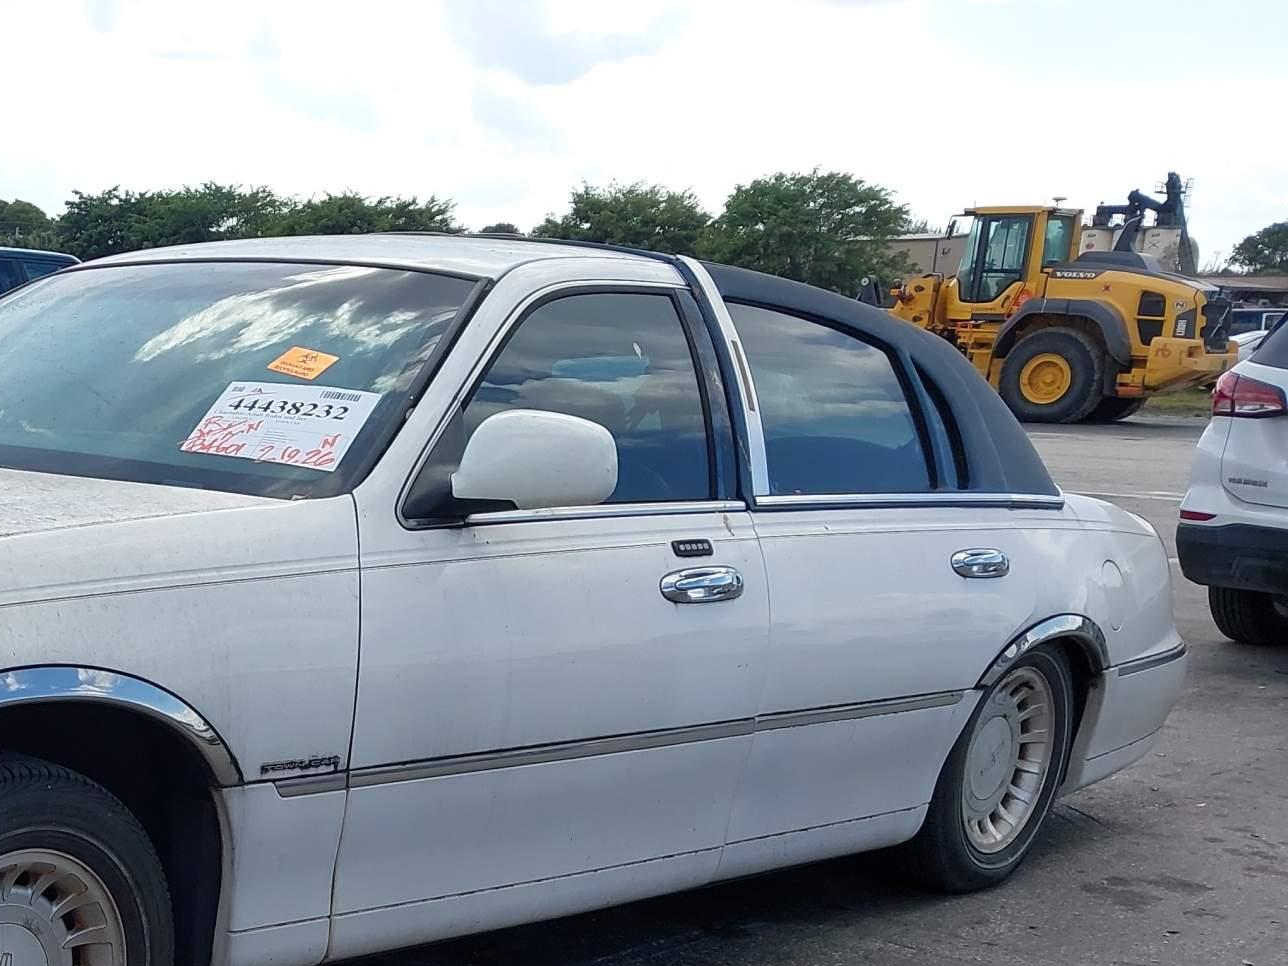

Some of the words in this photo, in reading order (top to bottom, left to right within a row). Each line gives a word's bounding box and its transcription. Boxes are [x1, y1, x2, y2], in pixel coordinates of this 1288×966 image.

[1055, 271, 1096, 279] VOLVO
[227, 397, 350, 421] 44438232
[262, 761, 306, 773] TOWN
[310, 756, 341, 768] CAR
